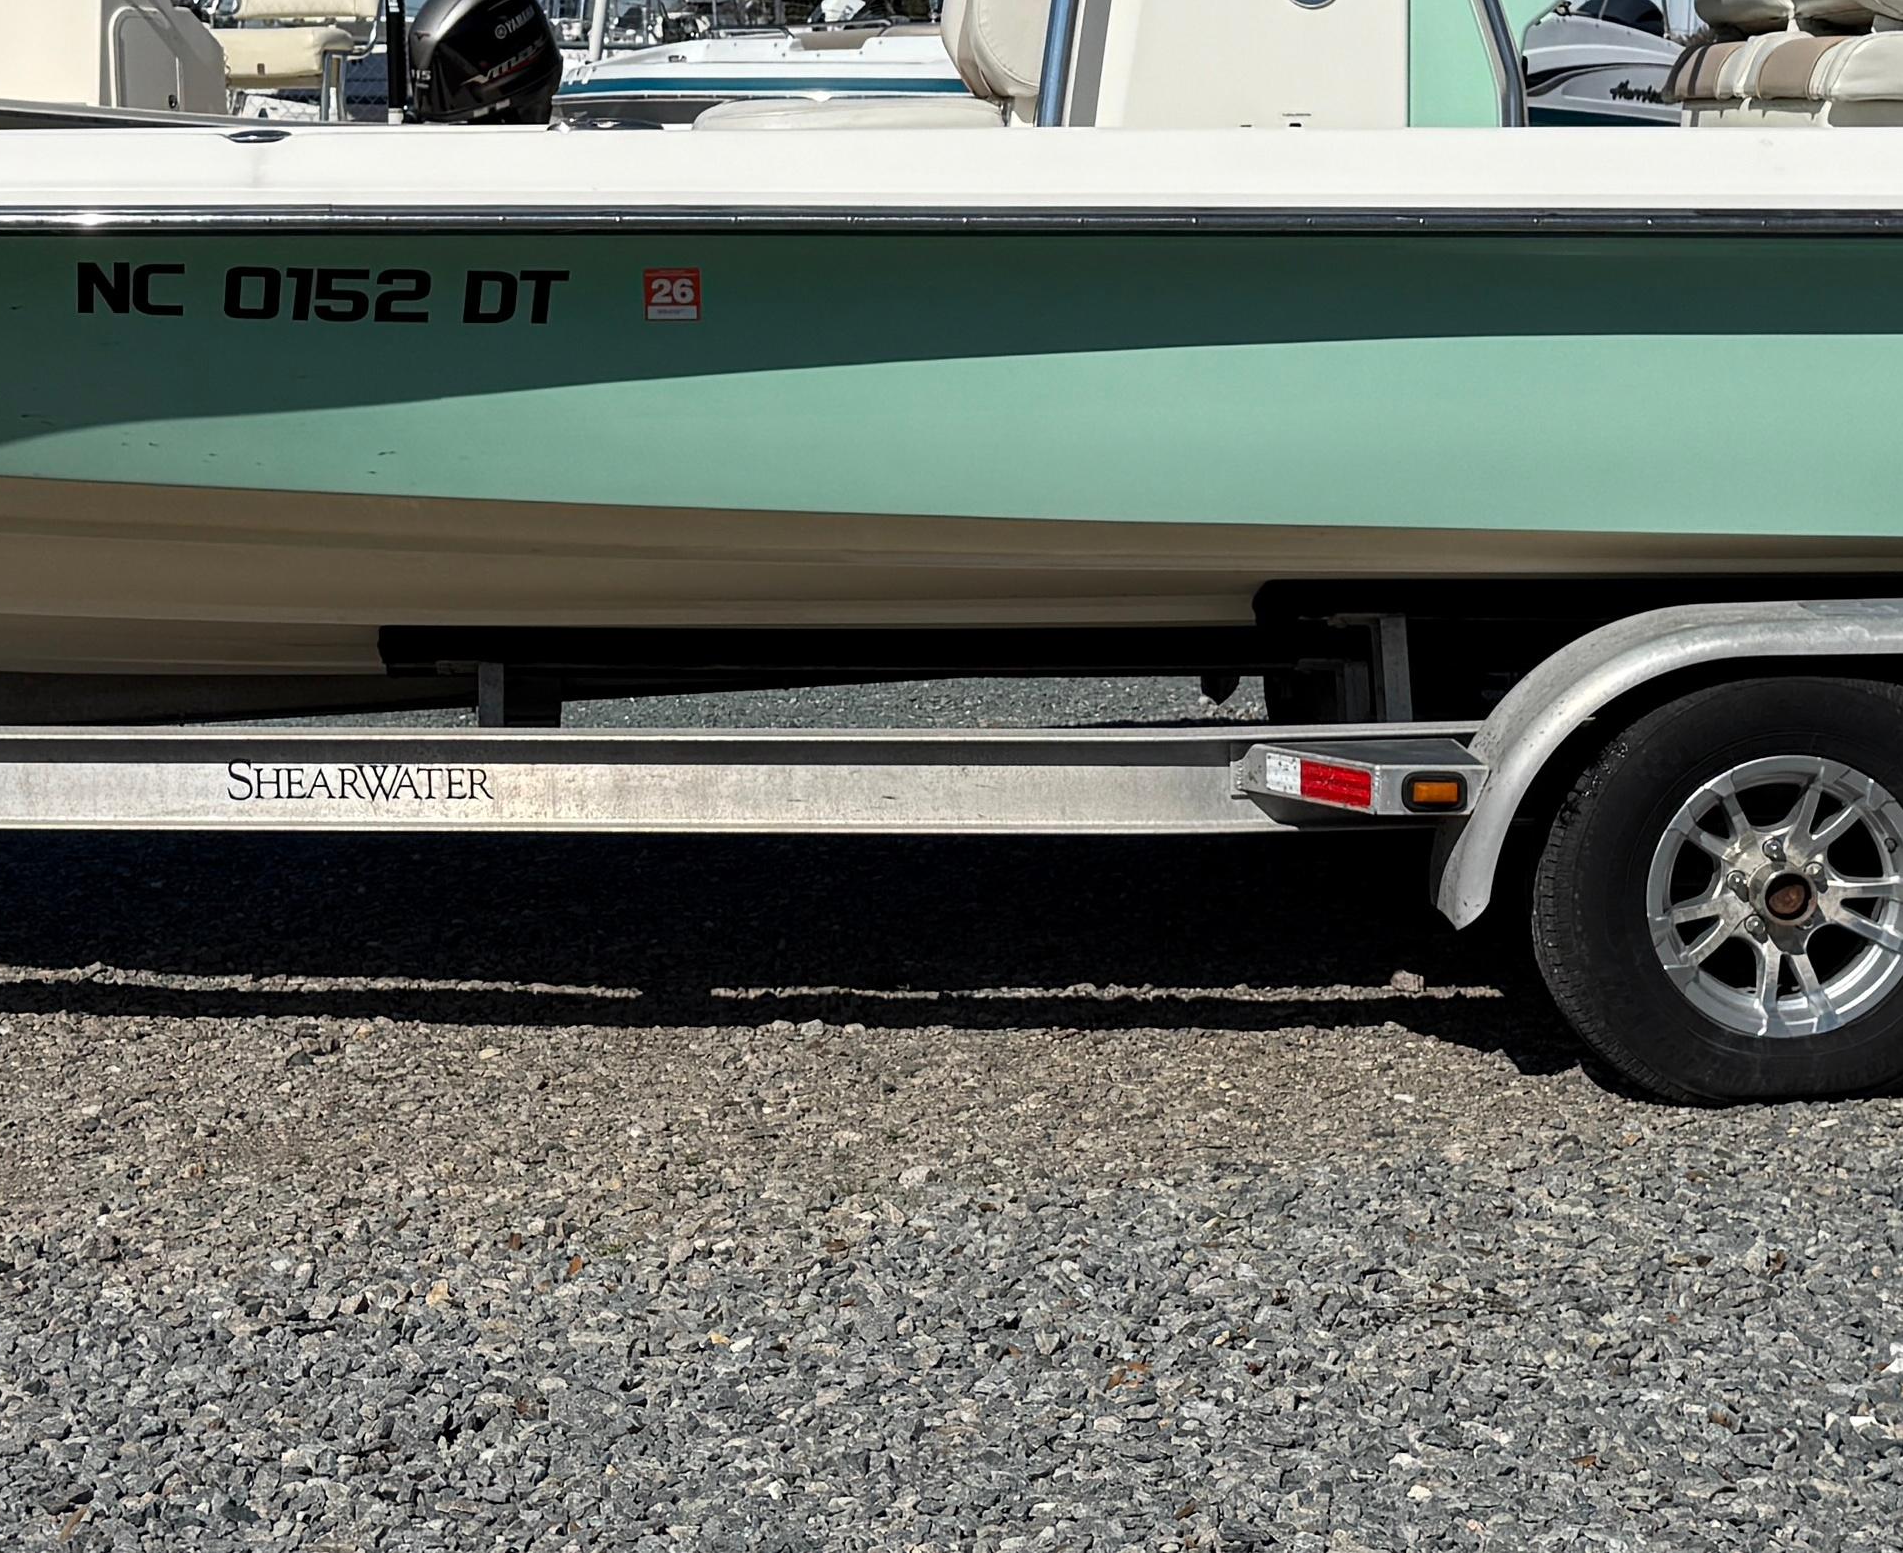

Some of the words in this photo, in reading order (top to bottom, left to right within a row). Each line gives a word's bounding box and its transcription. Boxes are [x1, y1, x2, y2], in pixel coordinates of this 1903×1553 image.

[77, 262, 185, 316] NC
[223, 265, 431, 323] 0152
[462, 270, 570, 324] DT
[651, 278, 695, 304] 26
[227, 758, 495, 802] SHEARWATER
